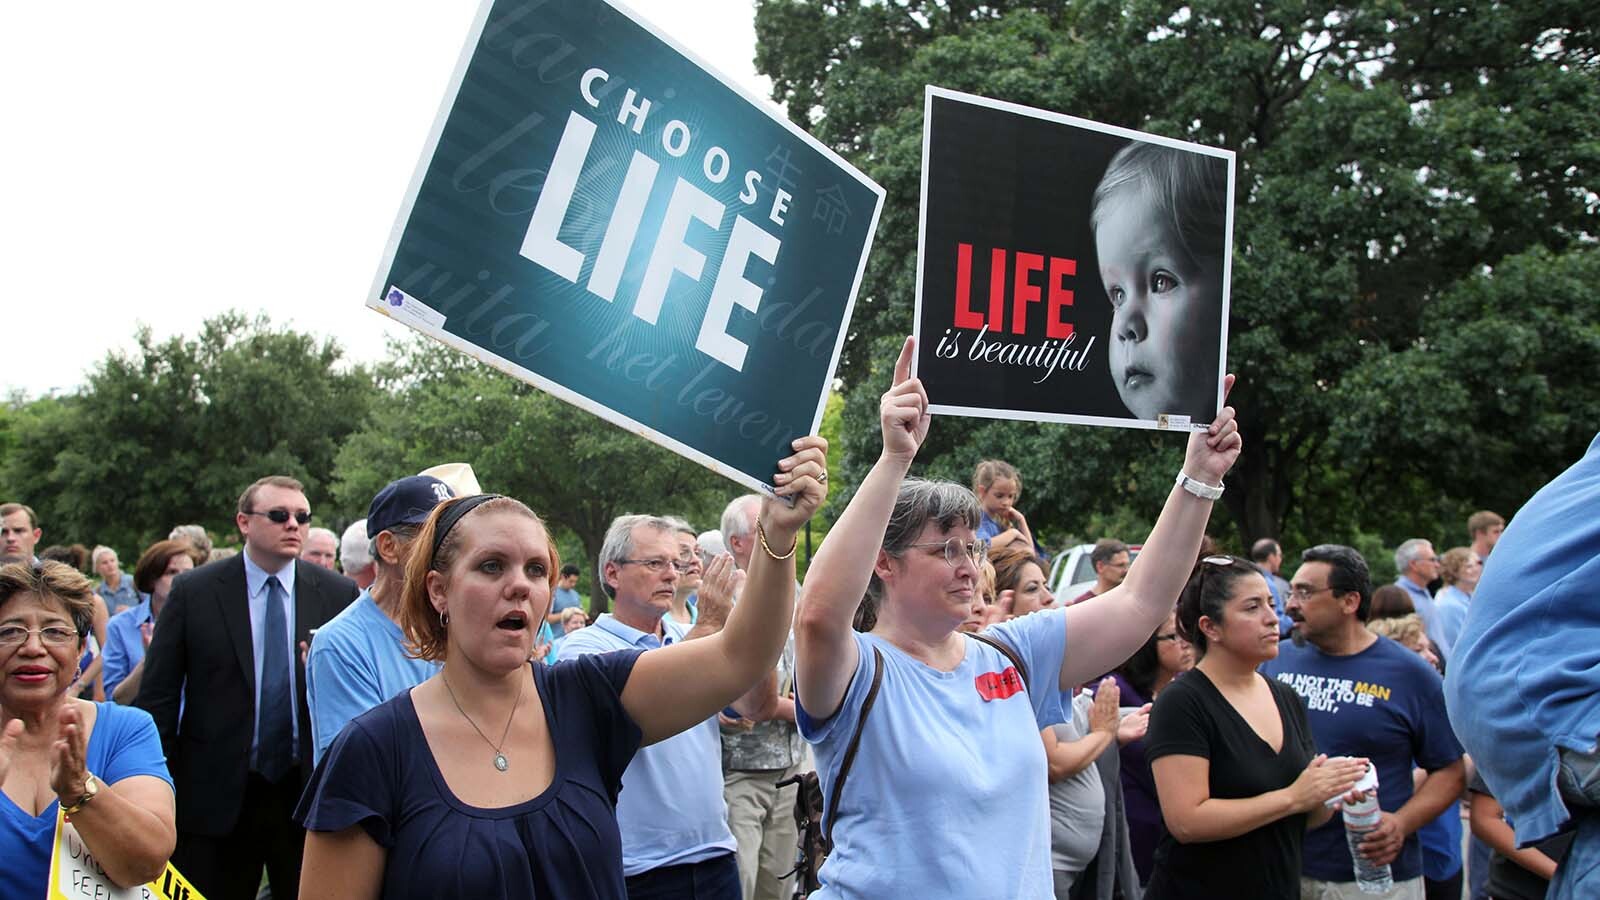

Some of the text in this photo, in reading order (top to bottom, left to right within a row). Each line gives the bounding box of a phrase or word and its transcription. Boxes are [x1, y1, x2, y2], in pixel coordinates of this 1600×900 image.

[579, 67, 792, 226] CHOOSE
[519, 110, 781, 372] LIFE
[954, 242, 1077, 340] LIFE
[935, 324, 1096, 384] is beautiful
[1294, 673, 1325, 688] NOT
[1327, 677, 1353, 692] THE
[1354, 681, 1391, 702] MAN
[1333, 688, 1355, 703] TO
[1356, 692, 1375, 707] BE
